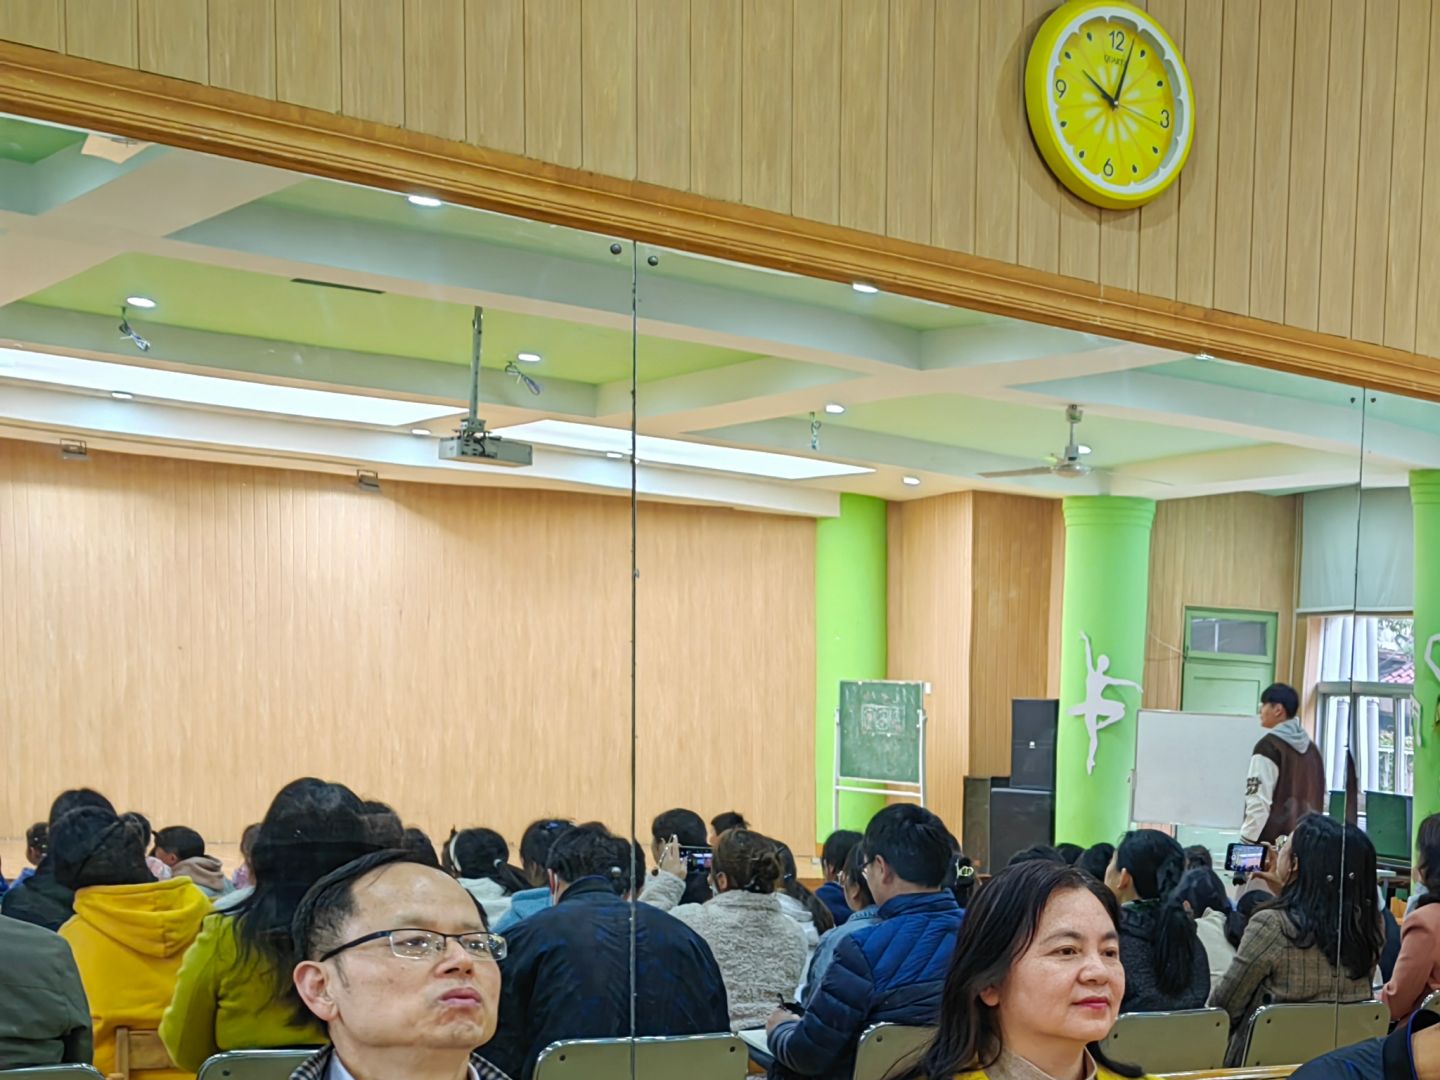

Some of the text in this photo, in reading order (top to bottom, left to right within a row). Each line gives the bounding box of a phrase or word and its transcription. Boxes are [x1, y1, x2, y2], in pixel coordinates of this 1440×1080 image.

[1108, 30, 1125, 52] 12
[1055, 79, 1067, 99] 9
[1159, 109, 1170, 129] 3
[1103, 158, 1114, 177] 6
